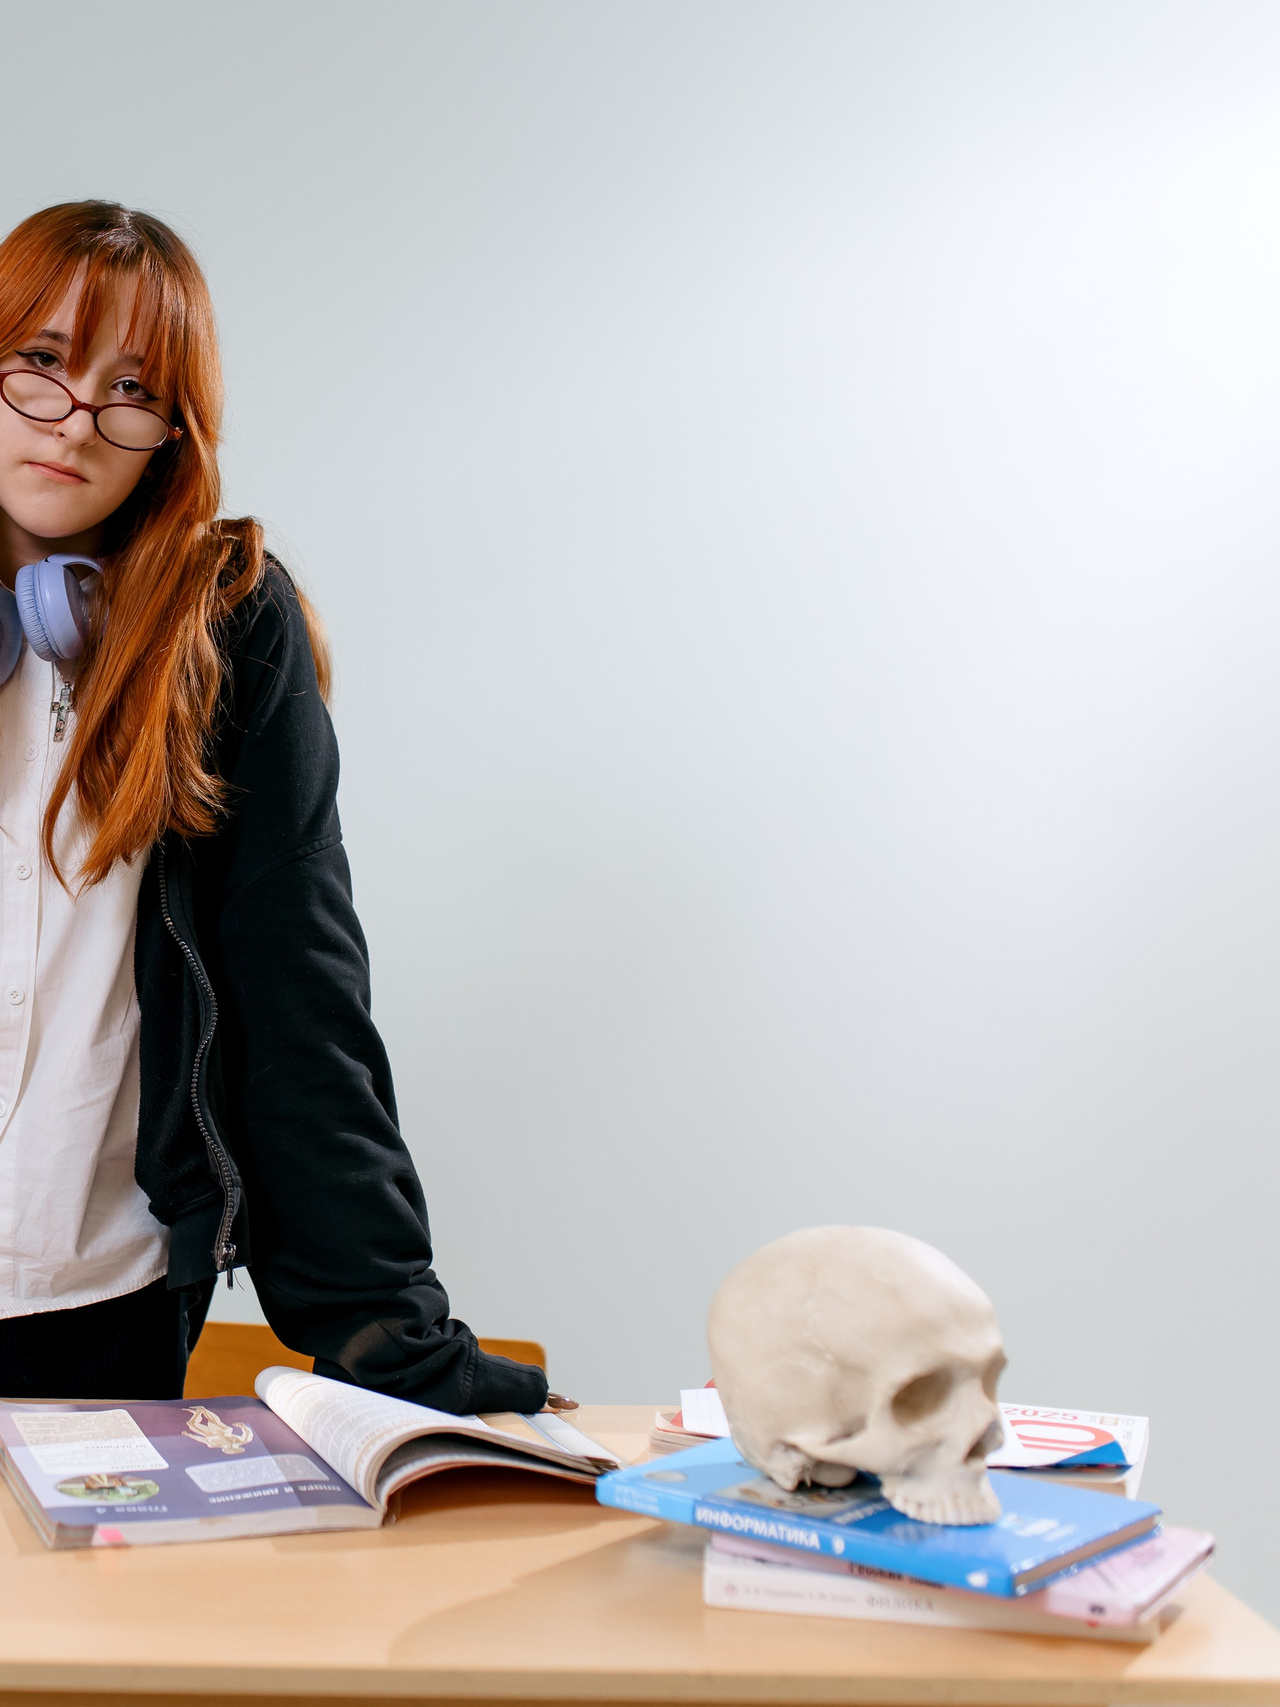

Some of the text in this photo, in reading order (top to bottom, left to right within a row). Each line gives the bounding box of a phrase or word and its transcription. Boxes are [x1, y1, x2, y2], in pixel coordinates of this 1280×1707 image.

[1003, 1407, 1078, 1421] 2025
[695, 1506, 820, 1550] ИНФОРМАТИКА
[831, 1537, 846, 1555] 9
